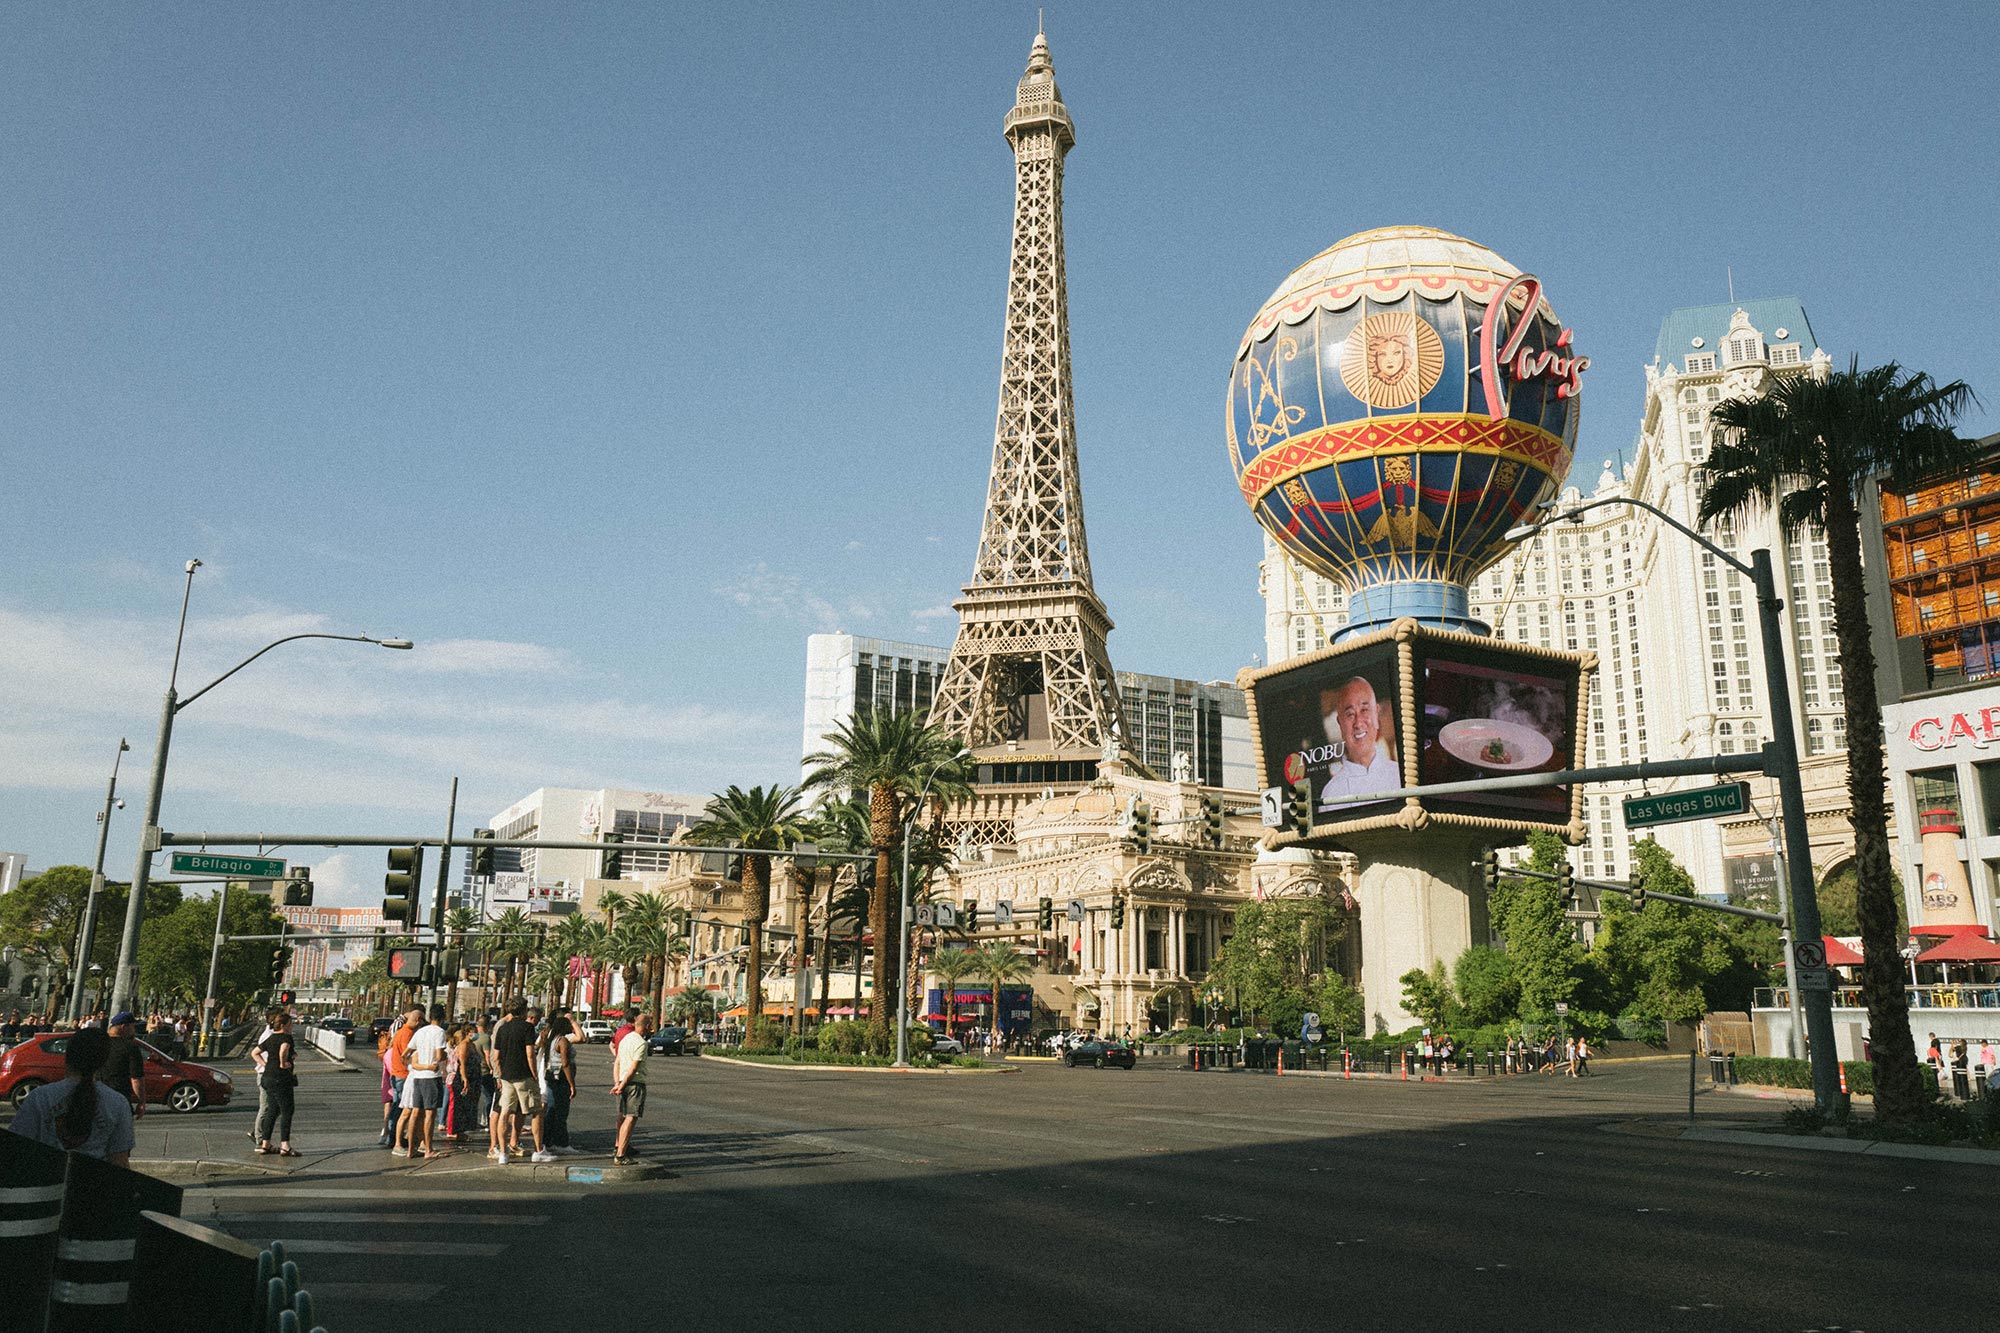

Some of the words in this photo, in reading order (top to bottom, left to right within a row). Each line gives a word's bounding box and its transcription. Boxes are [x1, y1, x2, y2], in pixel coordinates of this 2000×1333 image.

[1480, 273, 1591, 422] Paris
[1001, 753, 1053, 763] RESTAURANT
[1298, 741, 1346, 767] NOBU
[1628, 807, 1653, 820] Las
[1656, 800, 1699, 817] Vegas
[1702, 792, 1736, 809] Blvd
[191, 857, 252, 873] Bellagio
[263, 869, 281, 877] 2300
[507, 876, 528, 884] CAESARS
